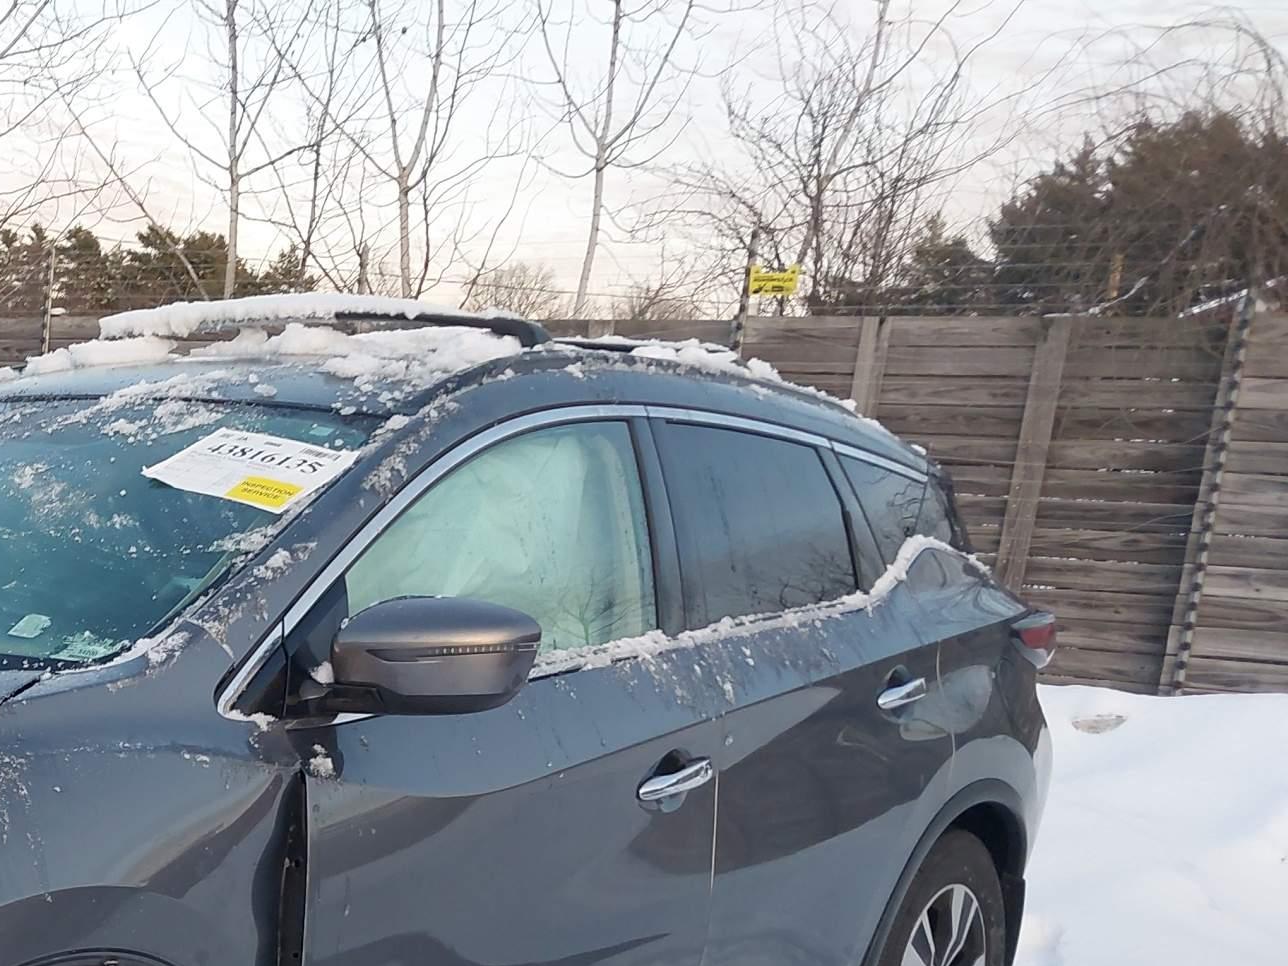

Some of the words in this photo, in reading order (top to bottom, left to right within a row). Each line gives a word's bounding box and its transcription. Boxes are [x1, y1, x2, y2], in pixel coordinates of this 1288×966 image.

[209, 443, 324, 474] 43816135
[240, 481, 294, 497] INSPECTION
[241, 488, 280, 500] SERVICE
